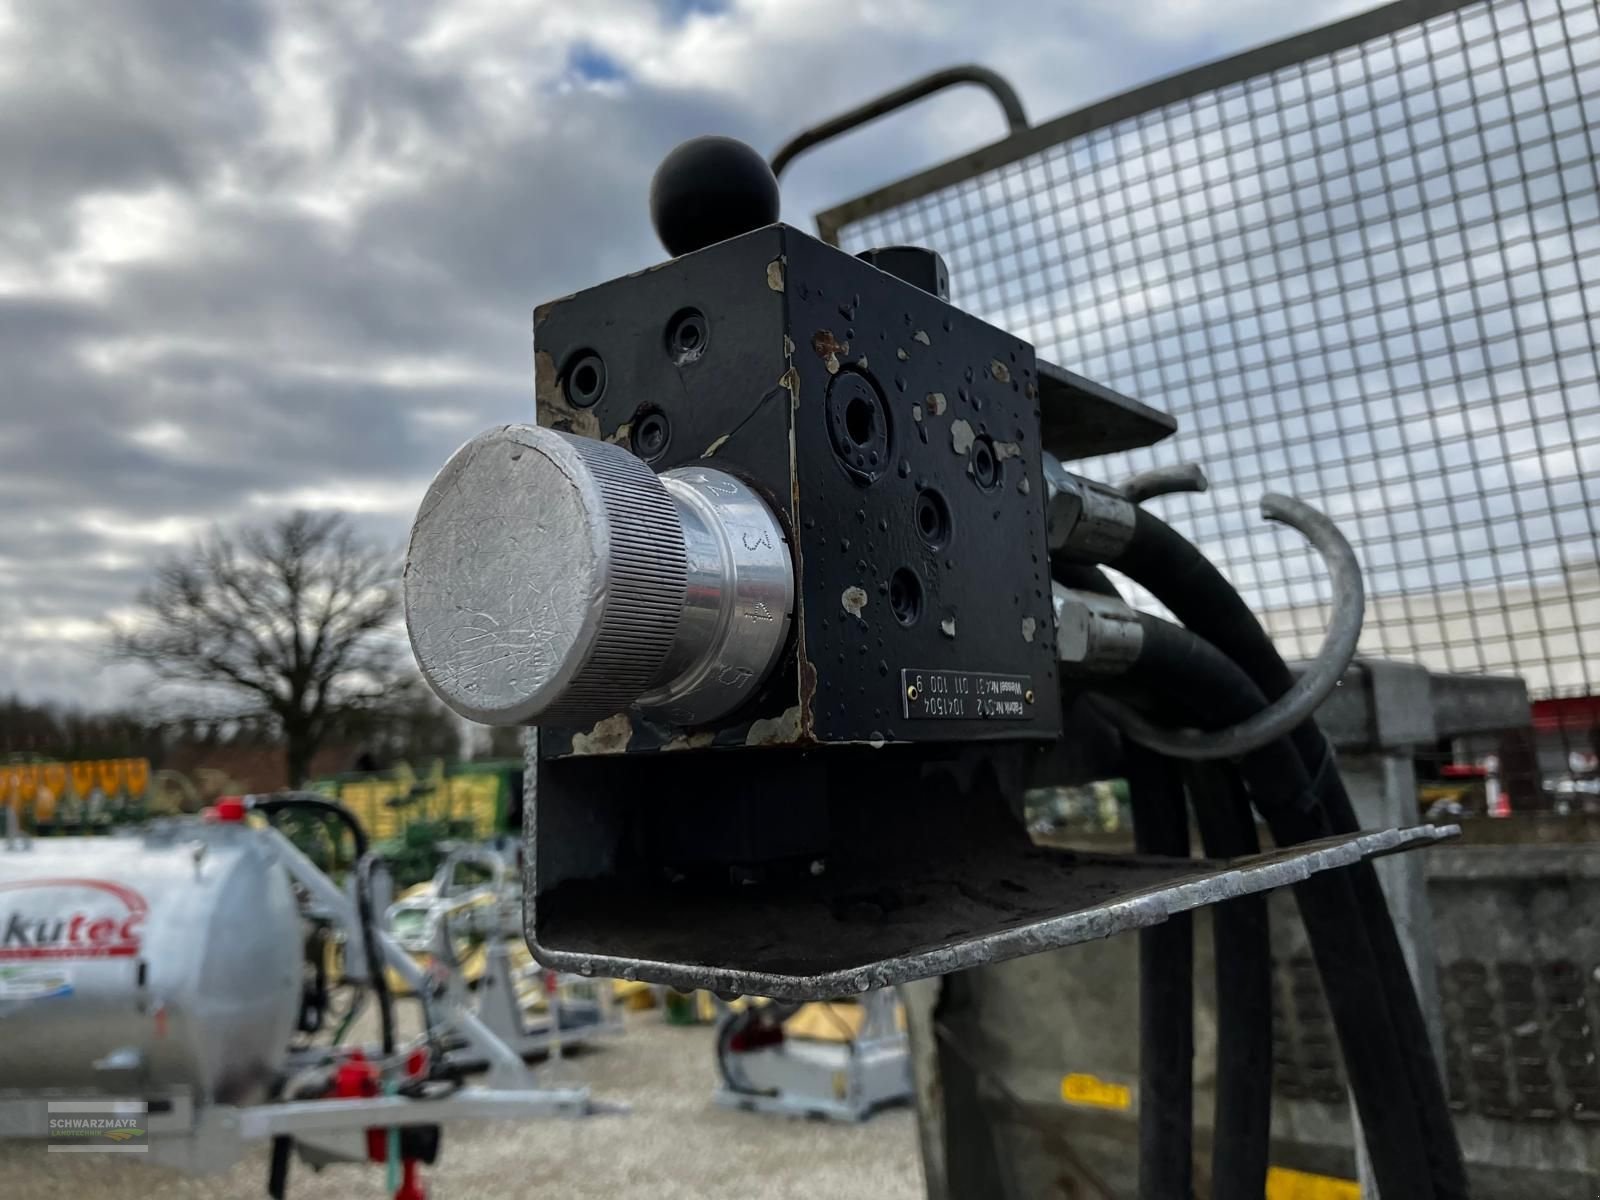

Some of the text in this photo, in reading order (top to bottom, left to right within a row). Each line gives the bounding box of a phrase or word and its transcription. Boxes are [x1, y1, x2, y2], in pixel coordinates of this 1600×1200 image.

[707, 481, 738, 497] 2
[742, 530, 773, 551] 3
[743, 602, 773, 624] 4
[718, 664, 753, 689] 5
[916, 675, 923, 693] 9
[930, 675, 948, 694] 100
[1000, 681, 1022, 696] Wessel
